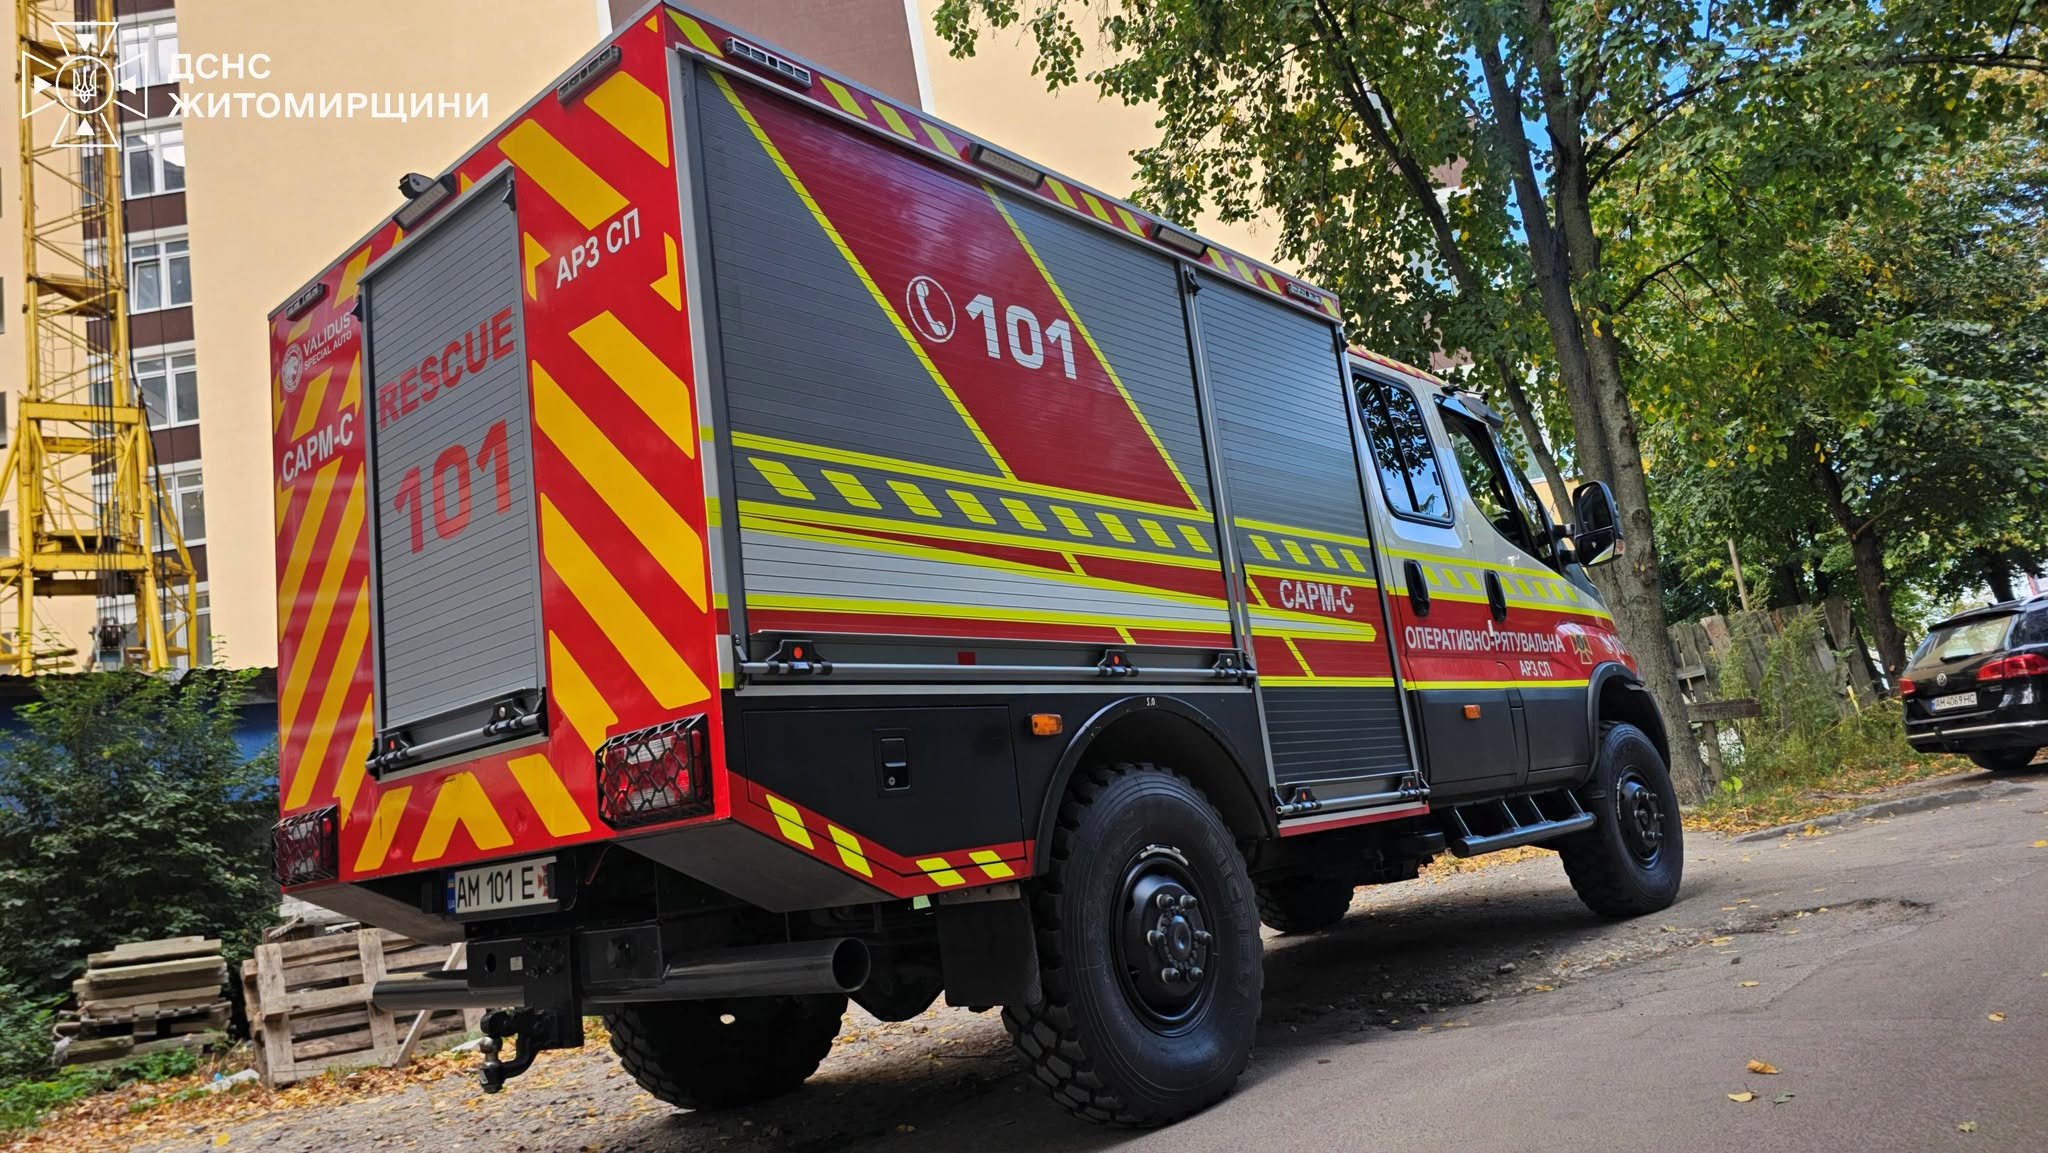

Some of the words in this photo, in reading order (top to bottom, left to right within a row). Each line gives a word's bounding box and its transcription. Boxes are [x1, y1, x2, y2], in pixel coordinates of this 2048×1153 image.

[556, 235, 600, 289] АРЗ
[606, 207, 640, 253] СП
[303, 311, 351, 356] VALIDUS
[304, 347, 332, 371] SPECIAL
[333, 330, 352, 351] AUTO
[965, 293, 1077, 379] 101
[378, 306, 514, 430] RESCUE
[282, 412, 353, 483] САРМ-С
[393, 418, 512, 554] 101
[1279, 579, 1354, 614] САРМ-С
[1405, 625, 1566, 653] ОПЕРАТИВНО-РЯТУВАЛЬНА
[1519, 660, 1537, 677] АРЗ
[1540, 661, 1553, 677] СП
[486, 869, 513, 904] 101
[522, 866, 534, 900] E
